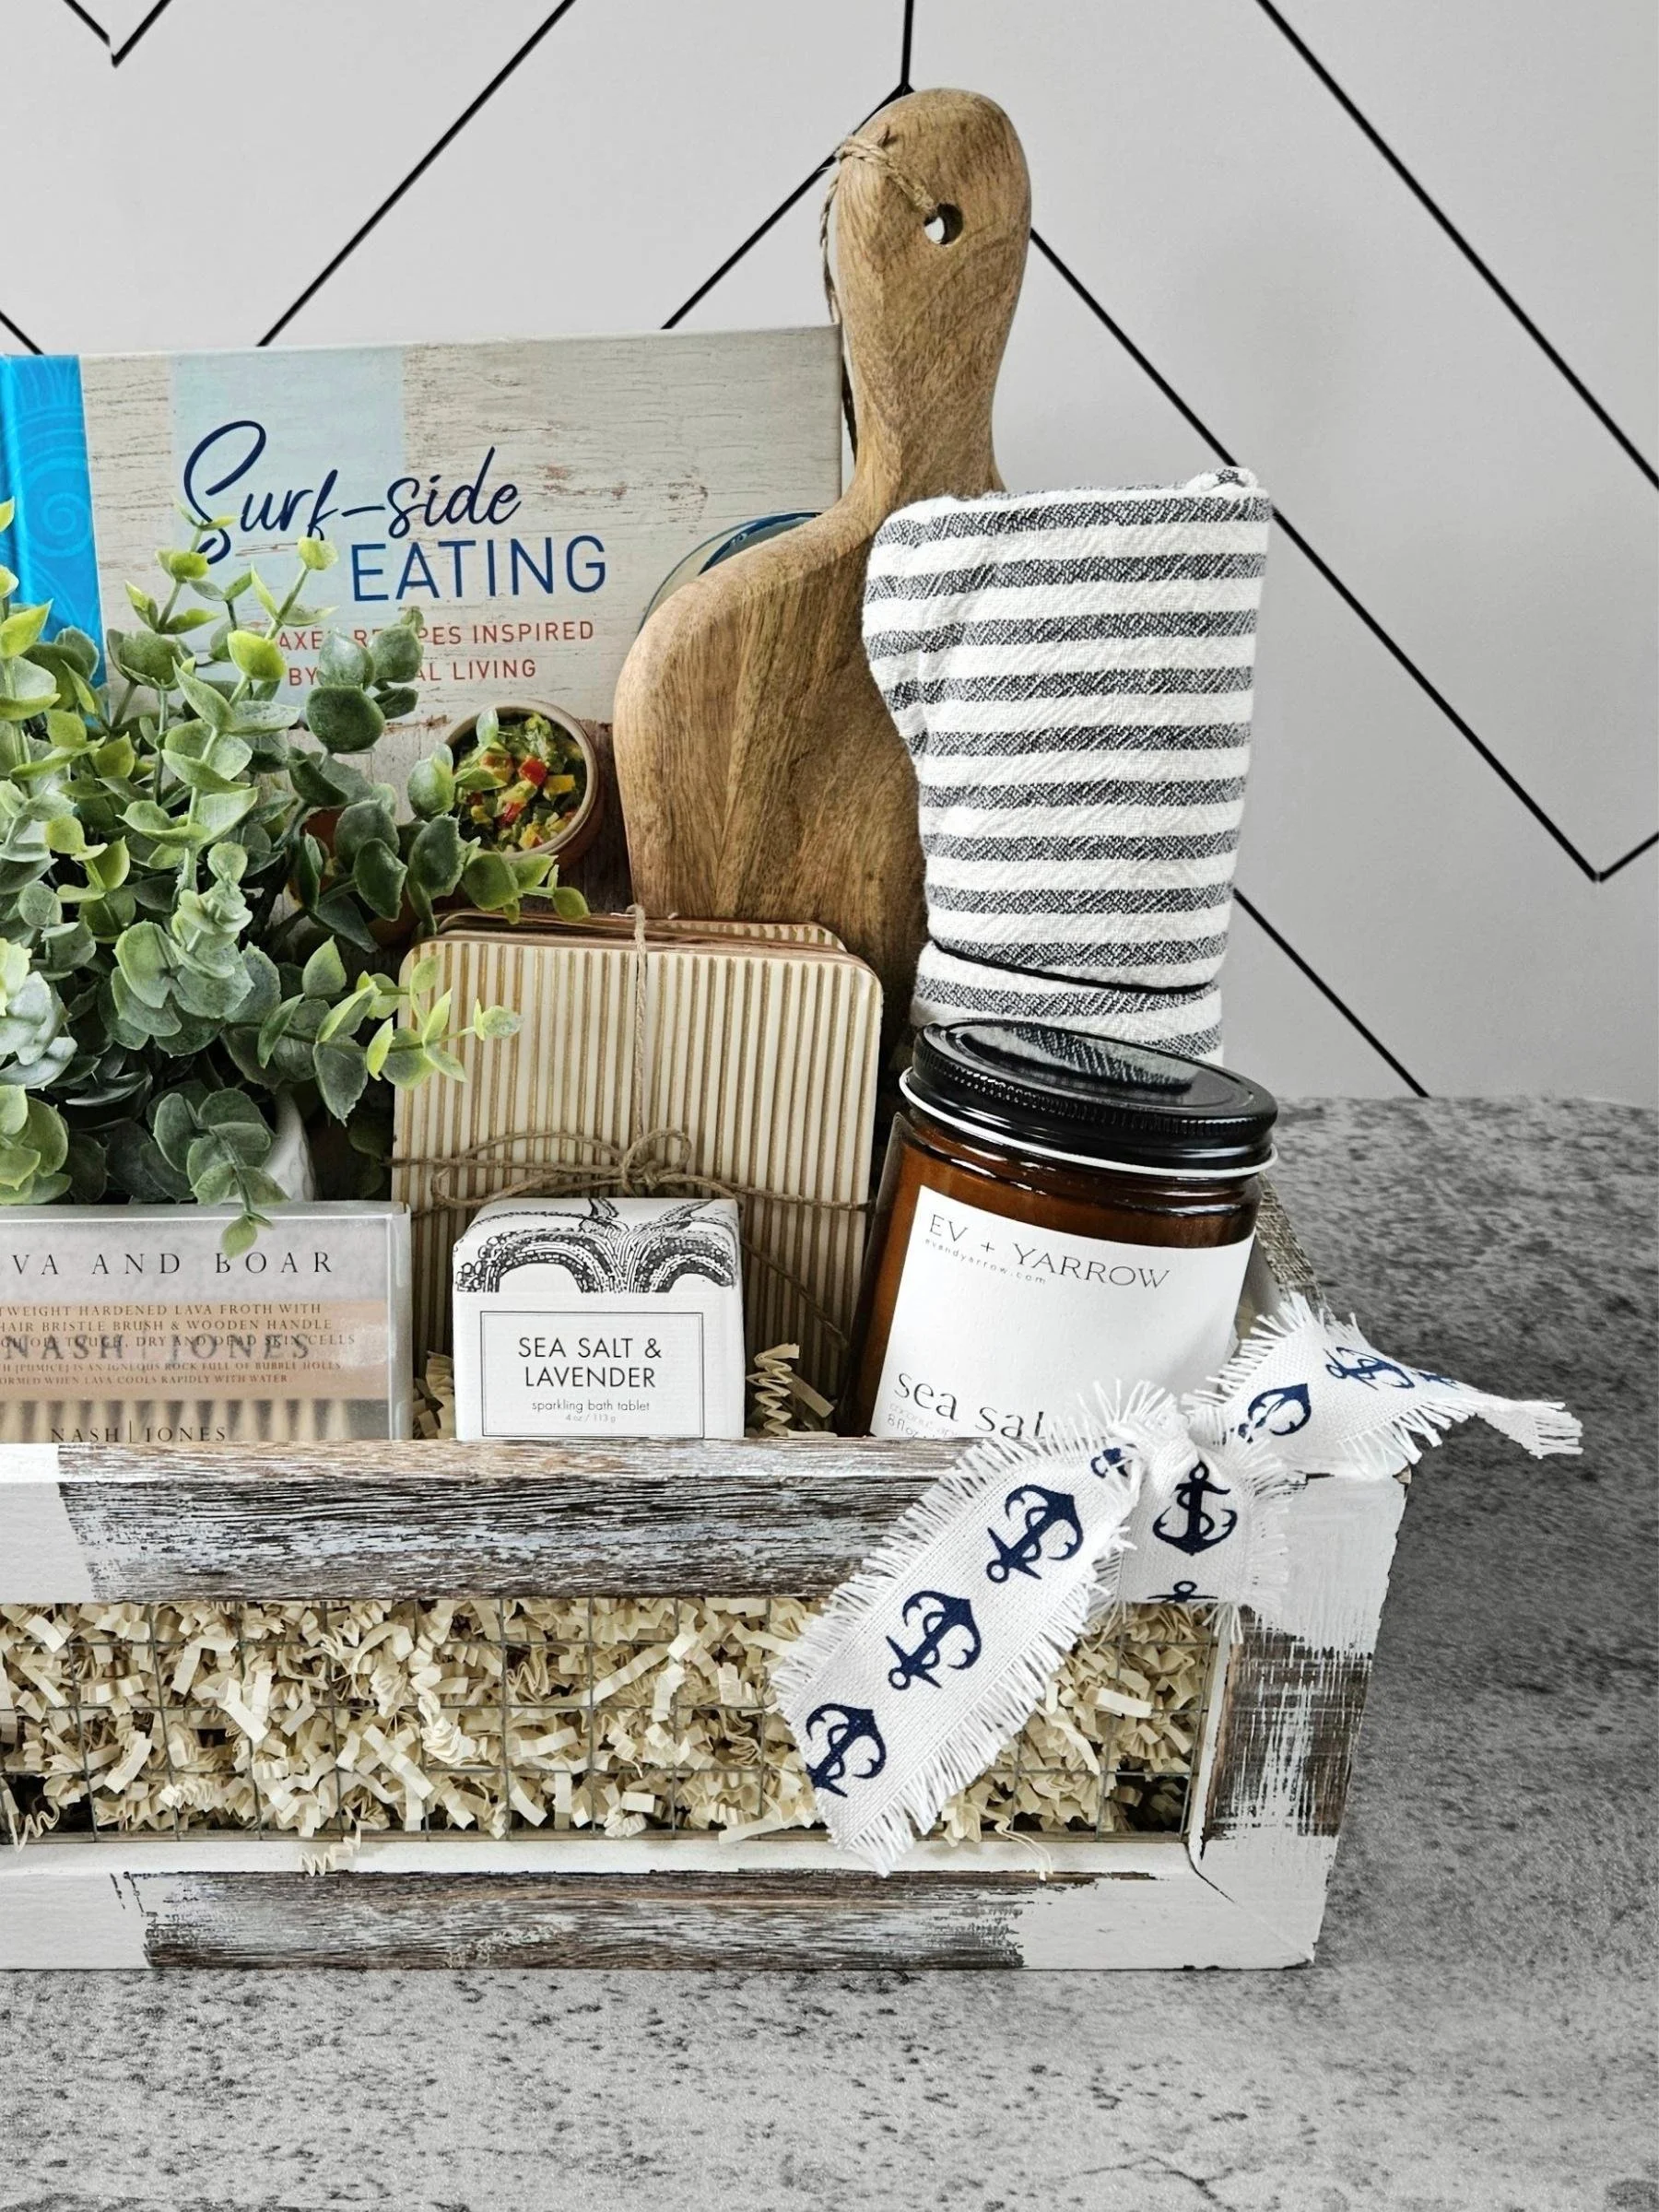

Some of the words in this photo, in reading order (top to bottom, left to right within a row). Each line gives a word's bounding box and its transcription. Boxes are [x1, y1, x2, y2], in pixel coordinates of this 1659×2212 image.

[183, 420, 523, 564] Surf-side
[352, 535, 606, 602] EATING
[474, 621, 594, 642] INSPIRED
[288, 667, 318, 686] BY
[453, 659, 536, 681] LIVING
[930, 1214, 968, 1241] EV
[981, 1241, 995, 1252] +
[1012, 1241, 1171, 1289] YARROW
[92, 1253, 181, 1276] AND
[215, 1251, 333, 1275] BOAR
[79, 1304, 168, 1316] HARDENED
[175, 1304, 212, 1315] LAVA
[220, 1303, 273, 1314] FROTH
[278, 1303, 322, 1314] WITH
[42, 1321, 105, 1332] BRISTLE
[113, 1320, 164, 1332] BRUSH
[171, 1320, 181, 1332] &
[186, 1319, 259, 1330] WOODEN
[267, 1319, 333, 1330] HANDLE
[5, 1334, 124, 1360] NASH
[171, 1334, 310, 1364] JONES
[135, 1336, 167, 1347] DRY
[308, 1334, 356, 1346] CELLS
[518, 1336, 567, 1359] SEA
[578, 1336, 634, 1359] SALT
[644, 1336, 663, 1359] &
[525, 1366, 656, 1388] LAVENDER
[532, 1399, 583, 1414] sparkling
[587, 1399, 613, 1411] bath
[618, 1399, 650, 1411] tablet
[894, 1372, 959, 1422] sea
[974, 1406, 1044, 1439] sal
[51, 1428, 119, 1443] NASH
[146, 1427, 226, 1442] JONES
